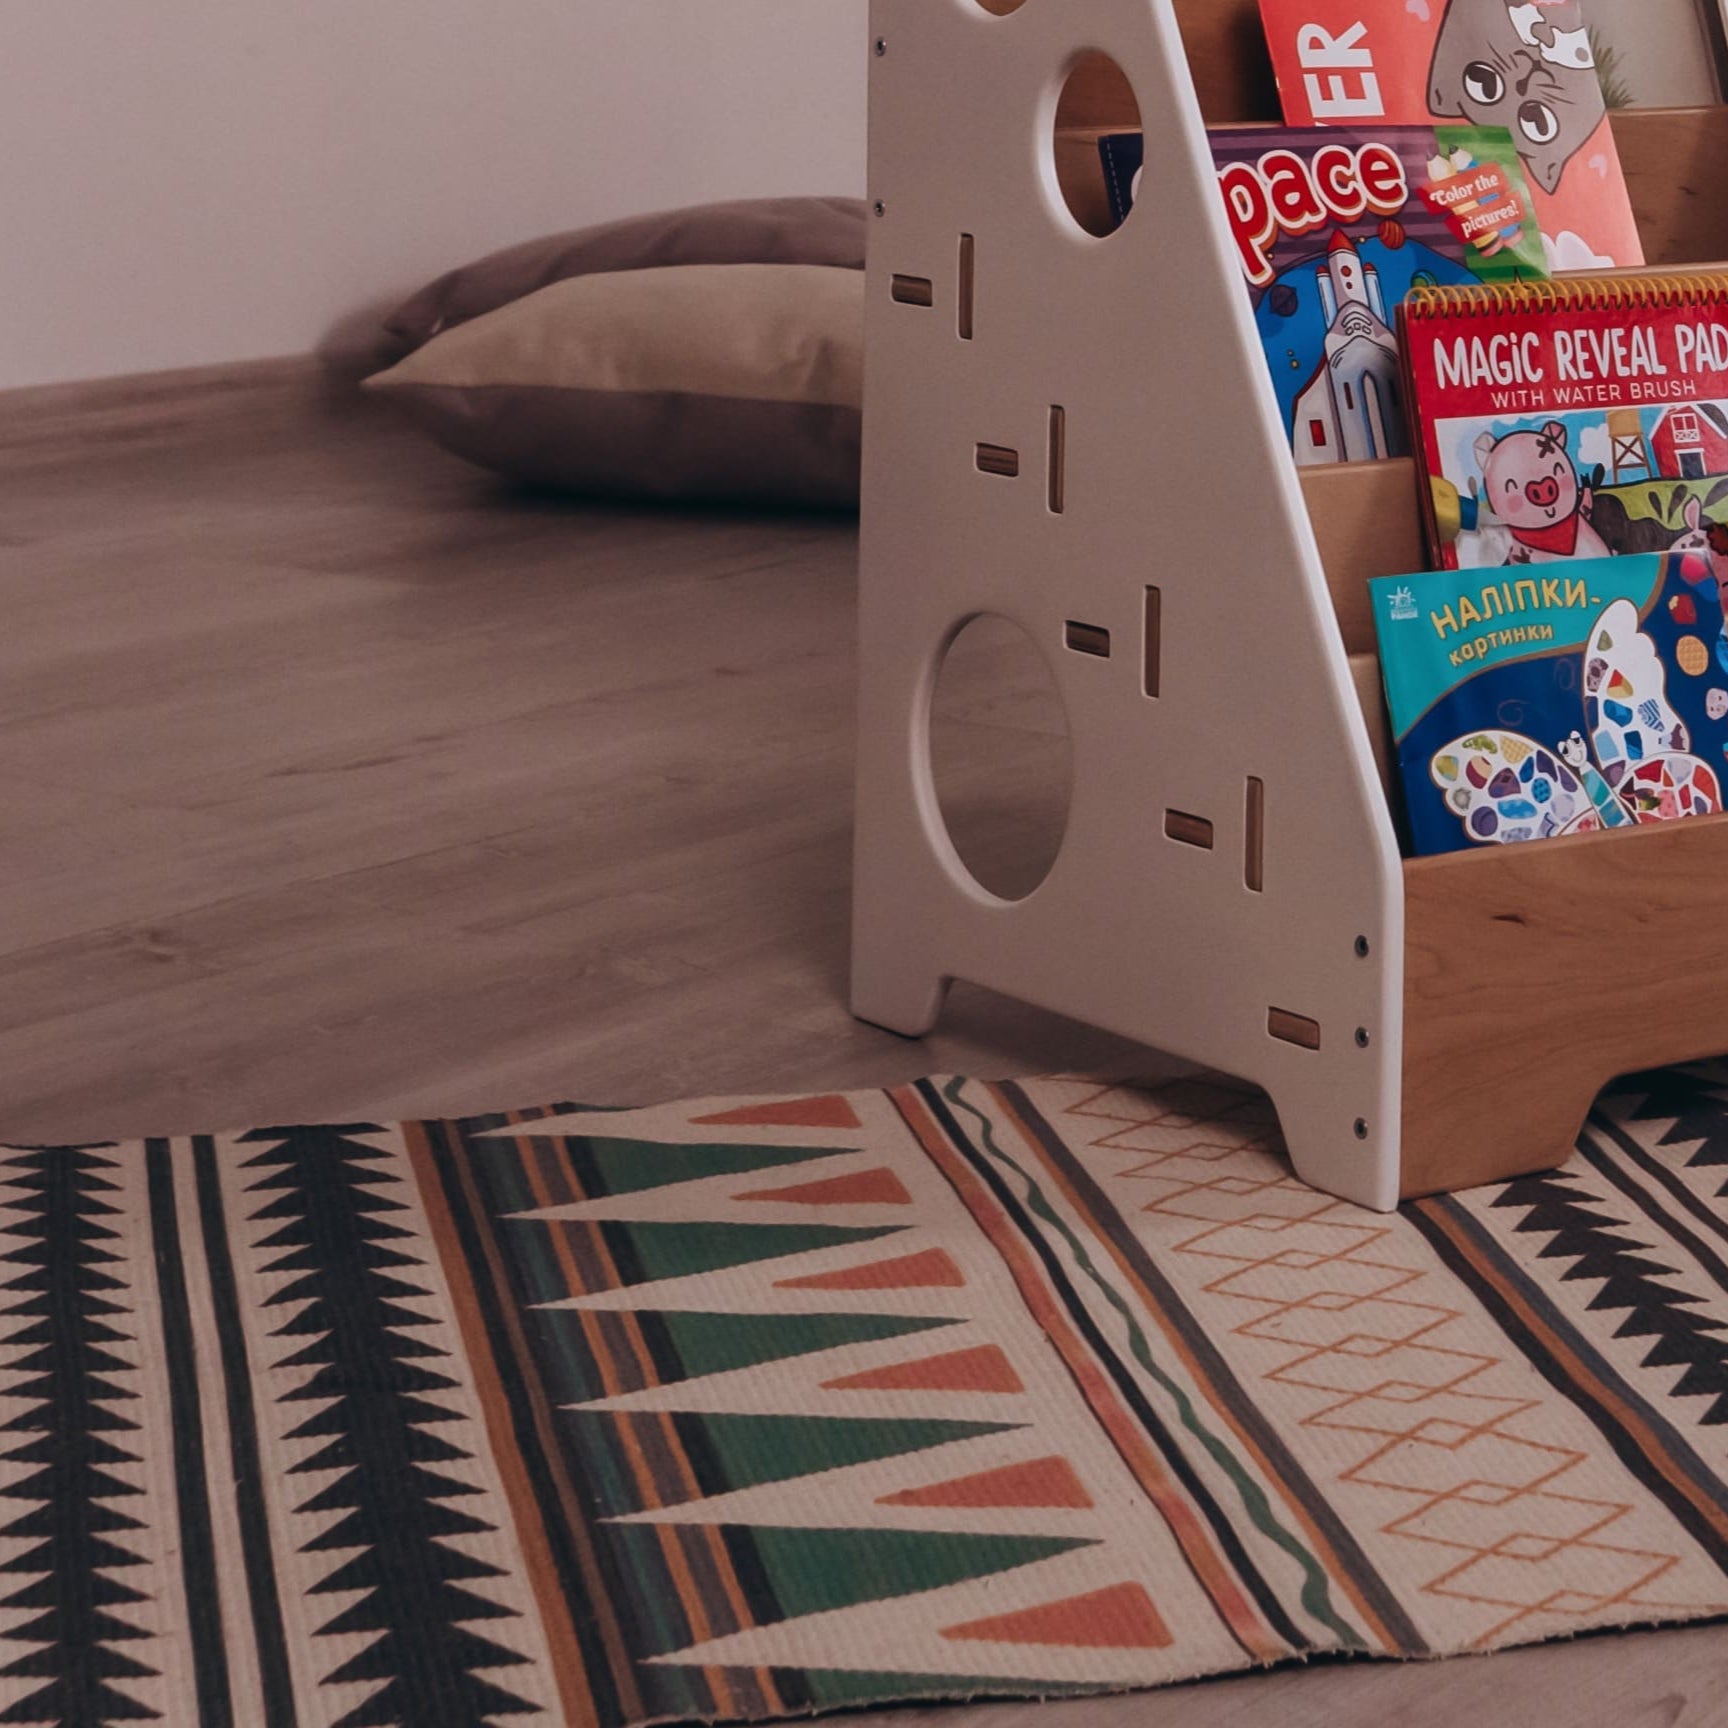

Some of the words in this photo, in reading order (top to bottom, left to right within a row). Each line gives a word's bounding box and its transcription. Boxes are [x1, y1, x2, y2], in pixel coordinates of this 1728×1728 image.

[1297, 21, 1386, 122] ER
[1429, 182, 1474, 206] Color
[1474, 174, 1500, 192] the
[1461, 199, 1520, 239] pictures!
[1555, 325, 1667, 383] REVEAL
[1491, 386, 1544, 409] WITH
[1552, 383, 1623, 407] WATER
[1630, 378, 1697, 401] BRUSH
[1429, 578, 1602, 640] НАЛІПКИ-
[1448, 624, 1555, 668] картинки
